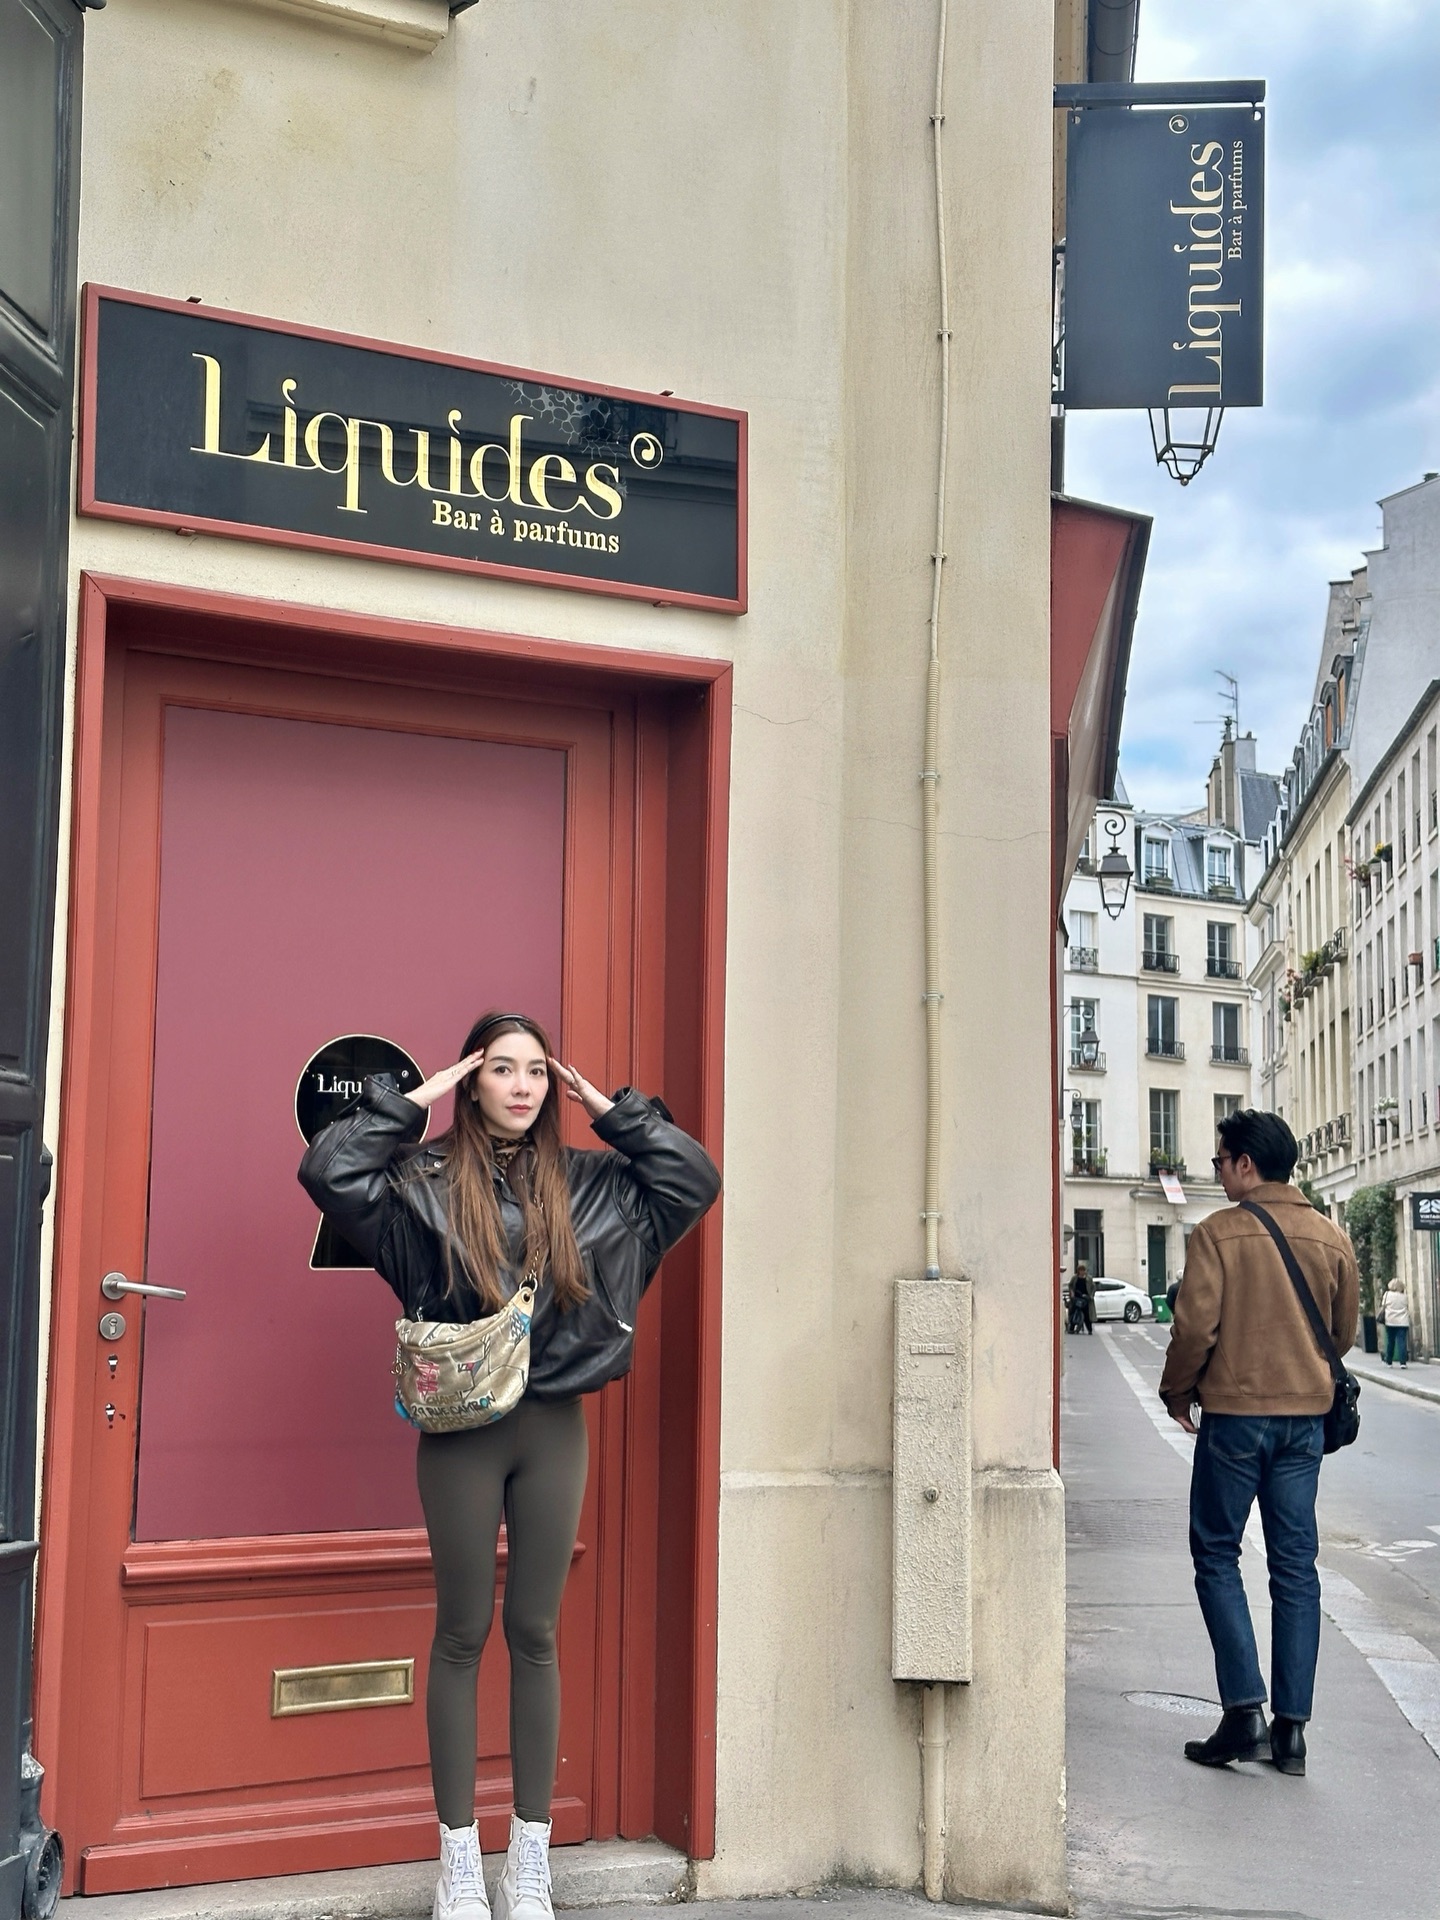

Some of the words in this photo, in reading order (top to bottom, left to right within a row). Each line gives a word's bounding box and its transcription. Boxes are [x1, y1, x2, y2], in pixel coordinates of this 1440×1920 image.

[1229, 140, 1248, 210] parfums
[1227, 229, 1243, 260] Bar
[1228, 214, 1243, 225] à
[1168, 141, 1242, 401] Liquides
[190, 352, 624, 520] Liquides
[432, 499, 482, 531] Bar
[490, 509, 505, 536] à
[513, 519, 620, 554] parfums
[317, 1073, 367, 1100] Liqu
